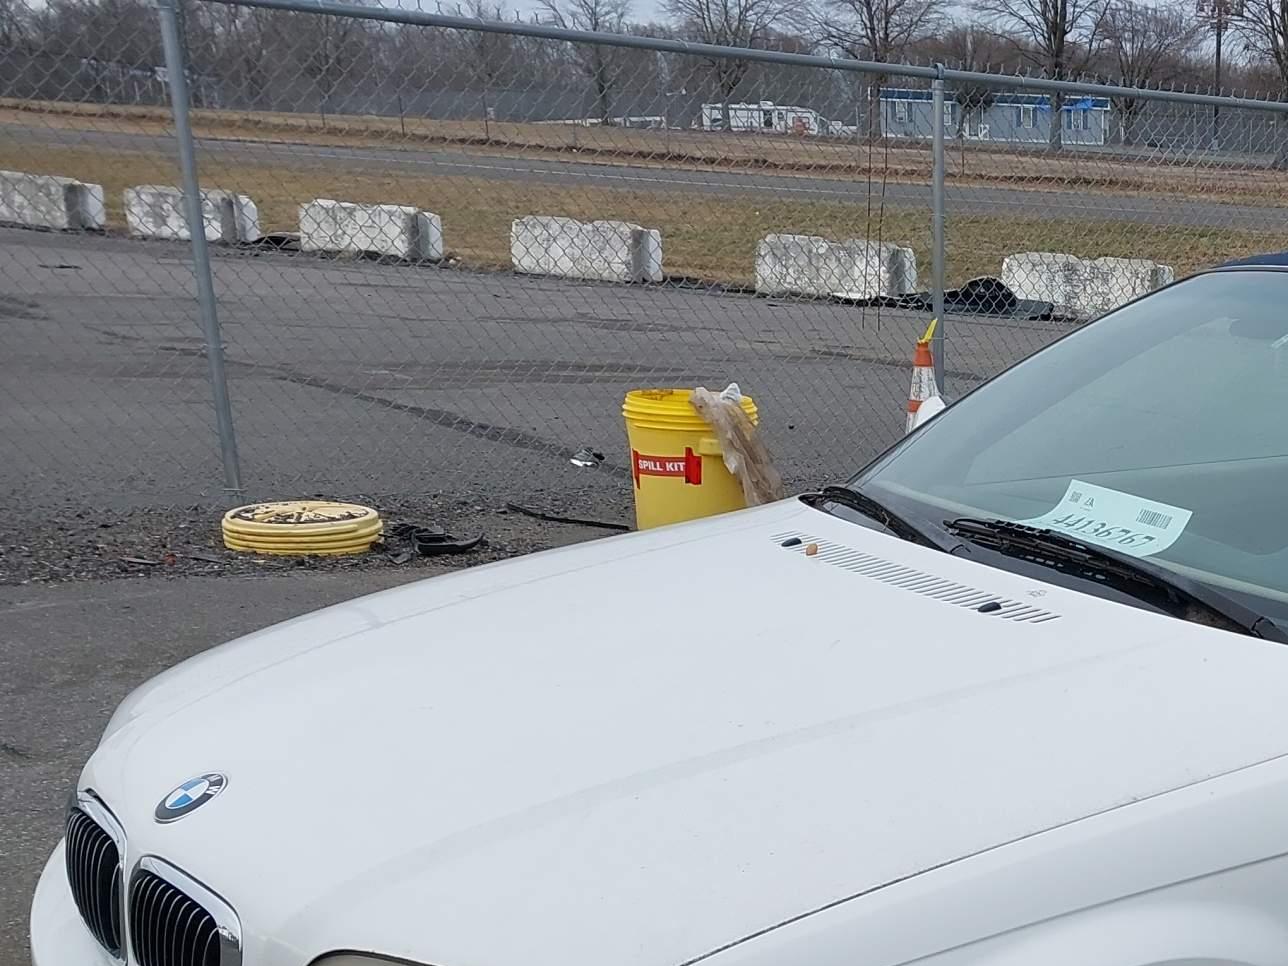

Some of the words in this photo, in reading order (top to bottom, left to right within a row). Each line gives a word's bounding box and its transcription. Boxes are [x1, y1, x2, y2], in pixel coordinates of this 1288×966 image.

[638, 459, 664, 472] SPILL
[665, 461, 686, 472] KIT
[1052, 513, 1157, 548] 44136767
